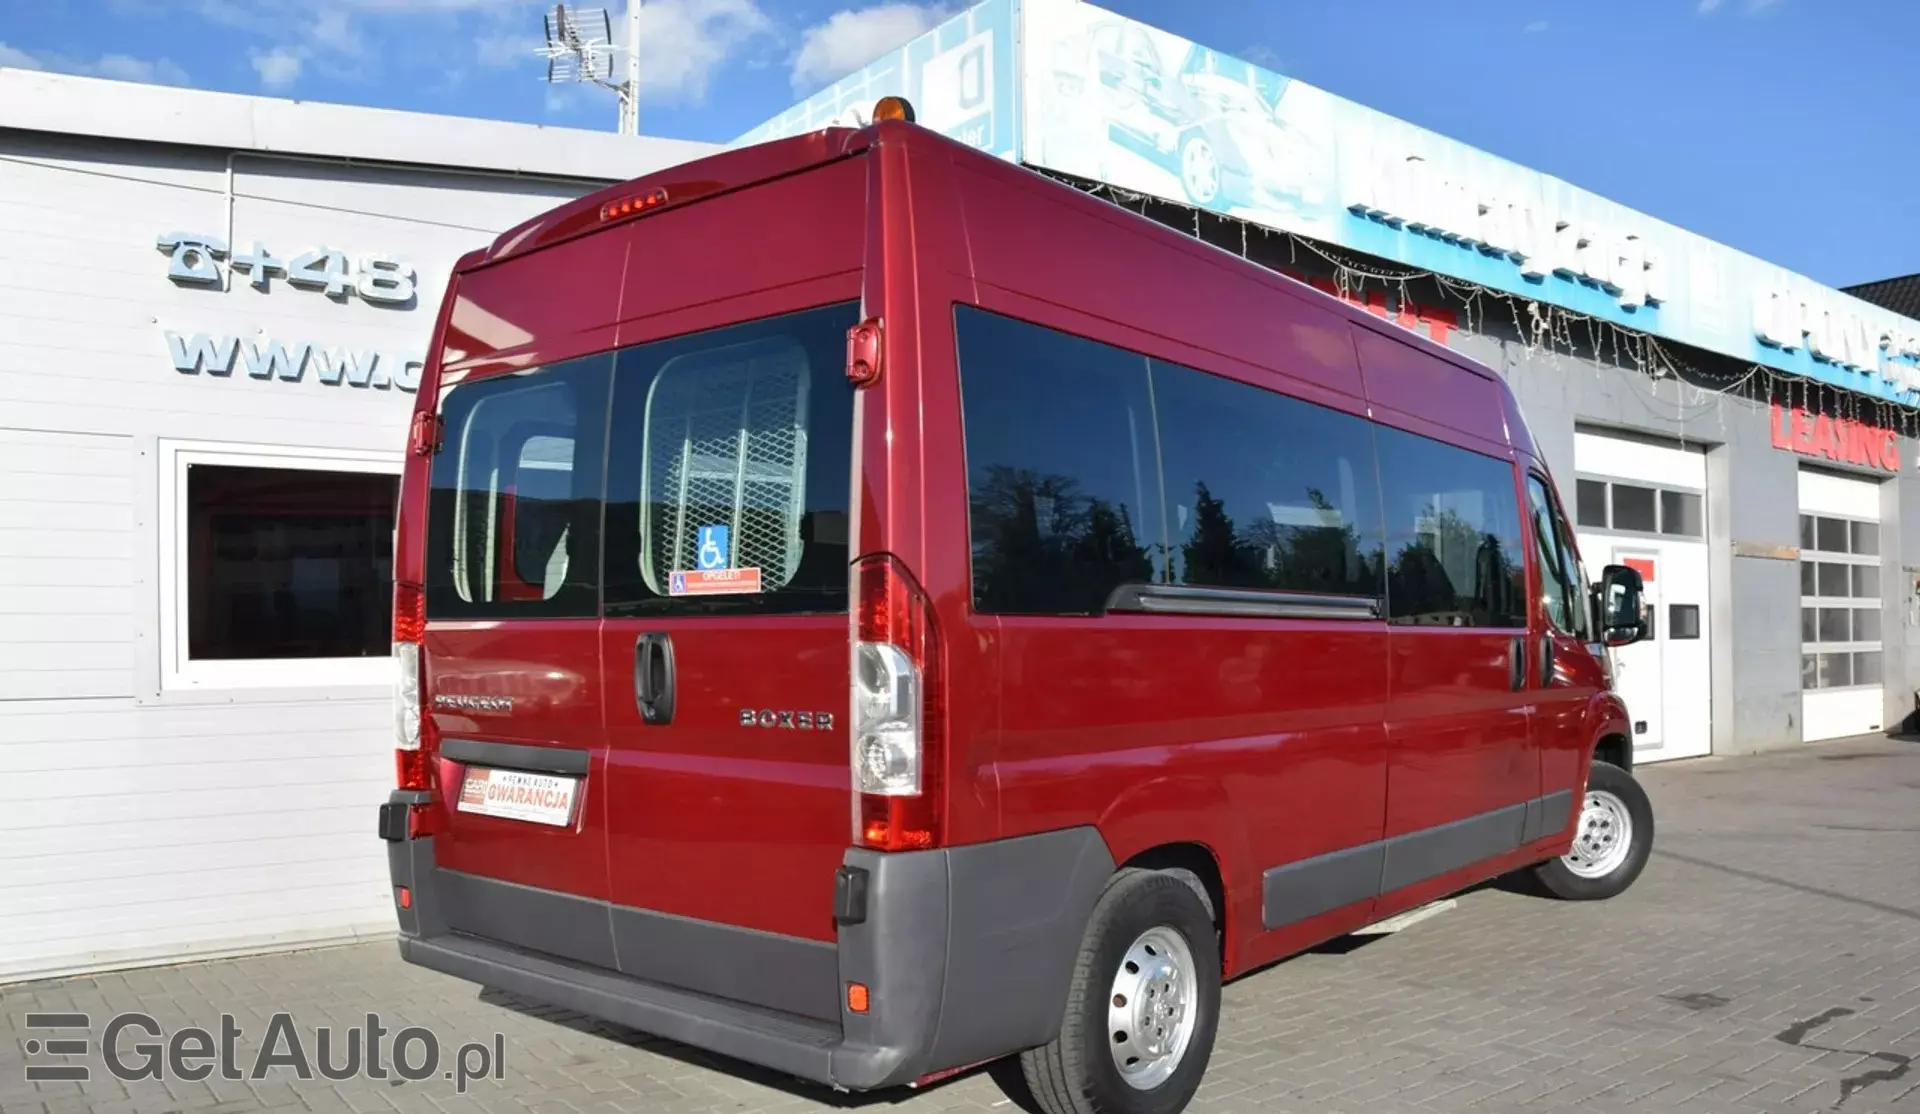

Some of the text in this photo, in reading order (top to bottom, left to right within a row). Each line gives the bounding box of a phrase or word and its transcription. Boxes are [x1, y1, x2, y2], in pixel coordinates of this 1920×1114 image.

[435, 694, 514, 712] PEUGEOT
[739, 709, 834, 730] BOXER
[488, 784, 569, 809] GWARANCJA
